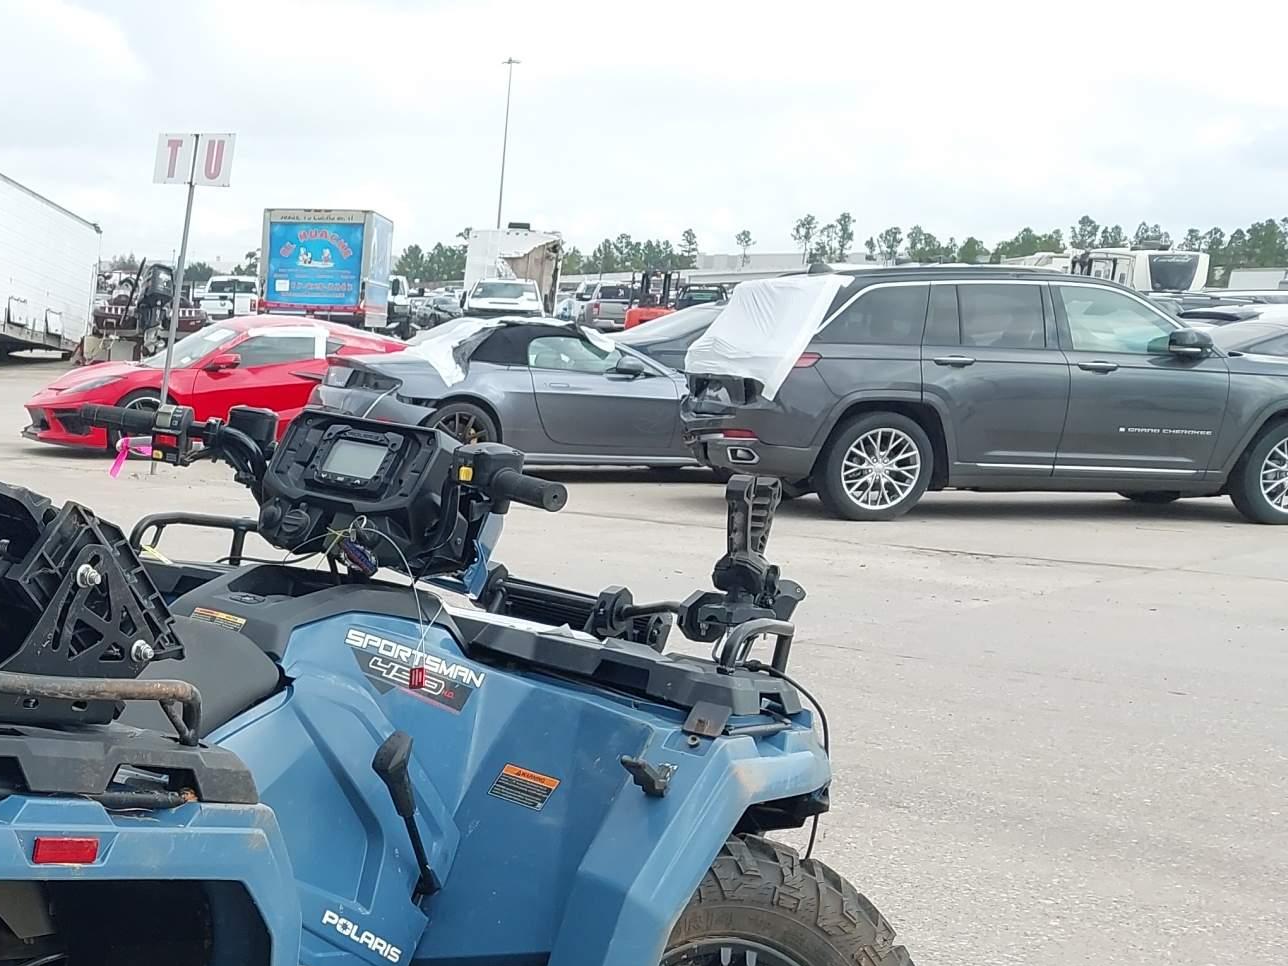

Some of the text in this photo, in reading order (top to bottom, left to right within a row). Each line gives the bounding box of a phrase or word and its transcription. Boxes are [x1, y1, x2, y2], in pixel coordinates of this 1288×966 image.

[167, 139, 225, 180] T U
[345, 628, 487, 689] SPORTSMAN
[321, 909, 402, 964] POLARIS
